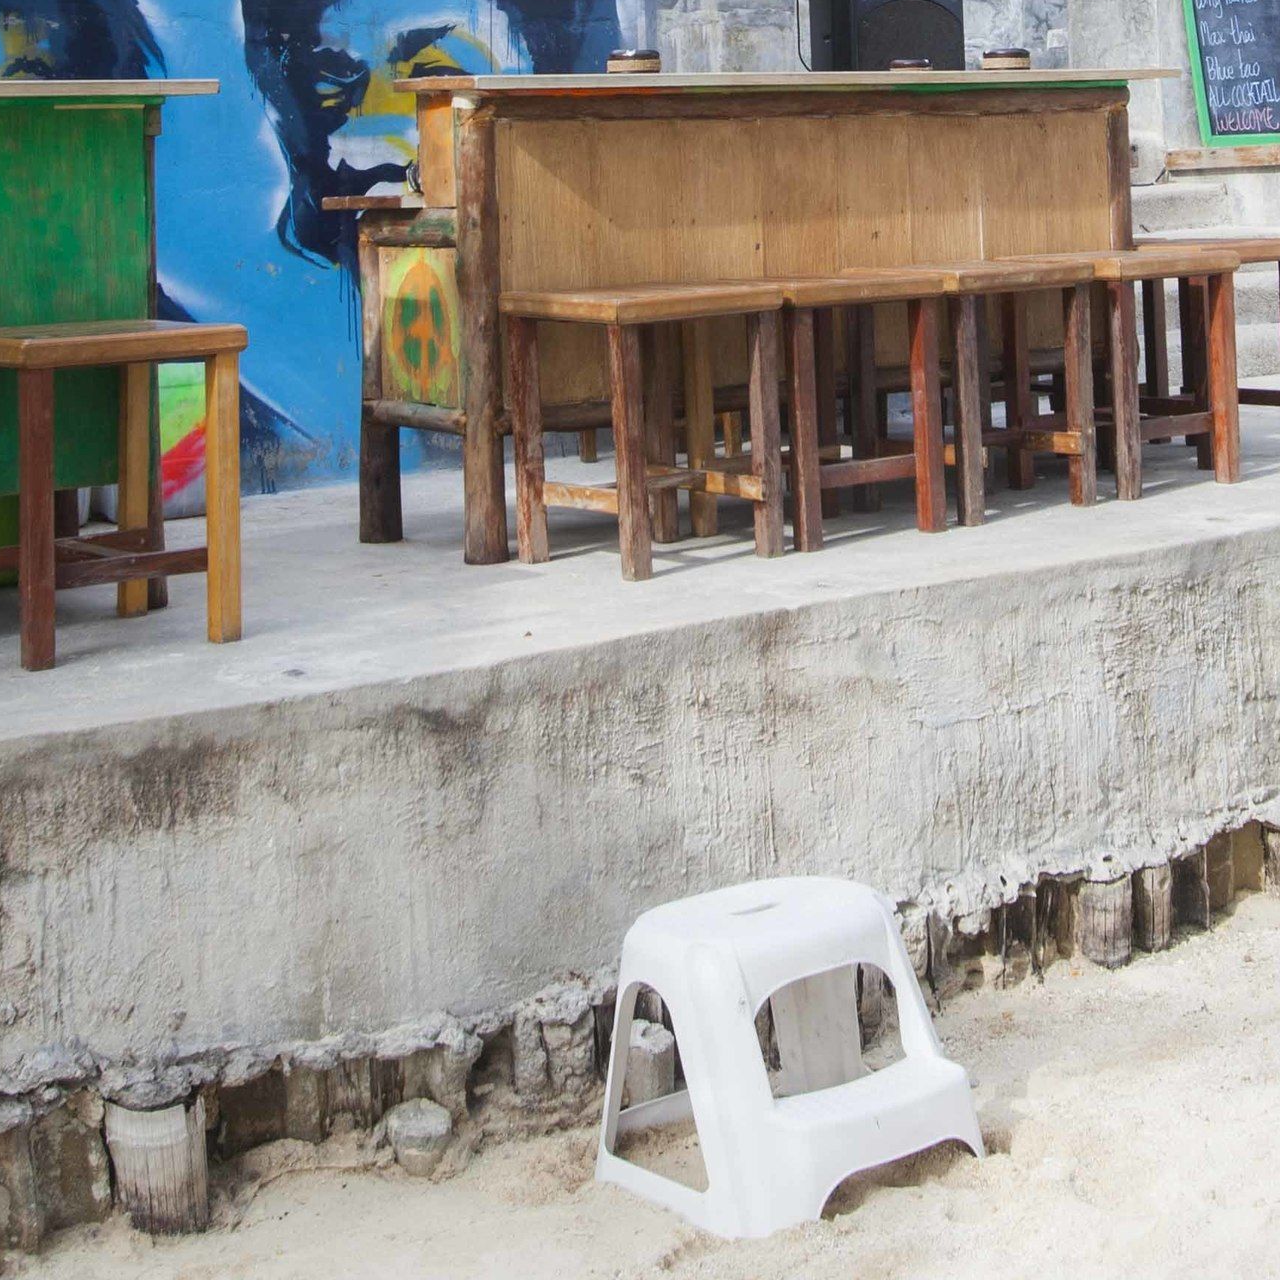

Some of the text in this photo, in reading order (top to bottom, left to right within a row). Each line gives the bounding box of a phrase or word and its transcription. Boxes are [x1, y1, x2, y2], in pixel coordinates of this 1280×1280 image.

[1206, 48, 1260, 80] Blue tao
[1215, 106, 1280, 132] WELCOME
